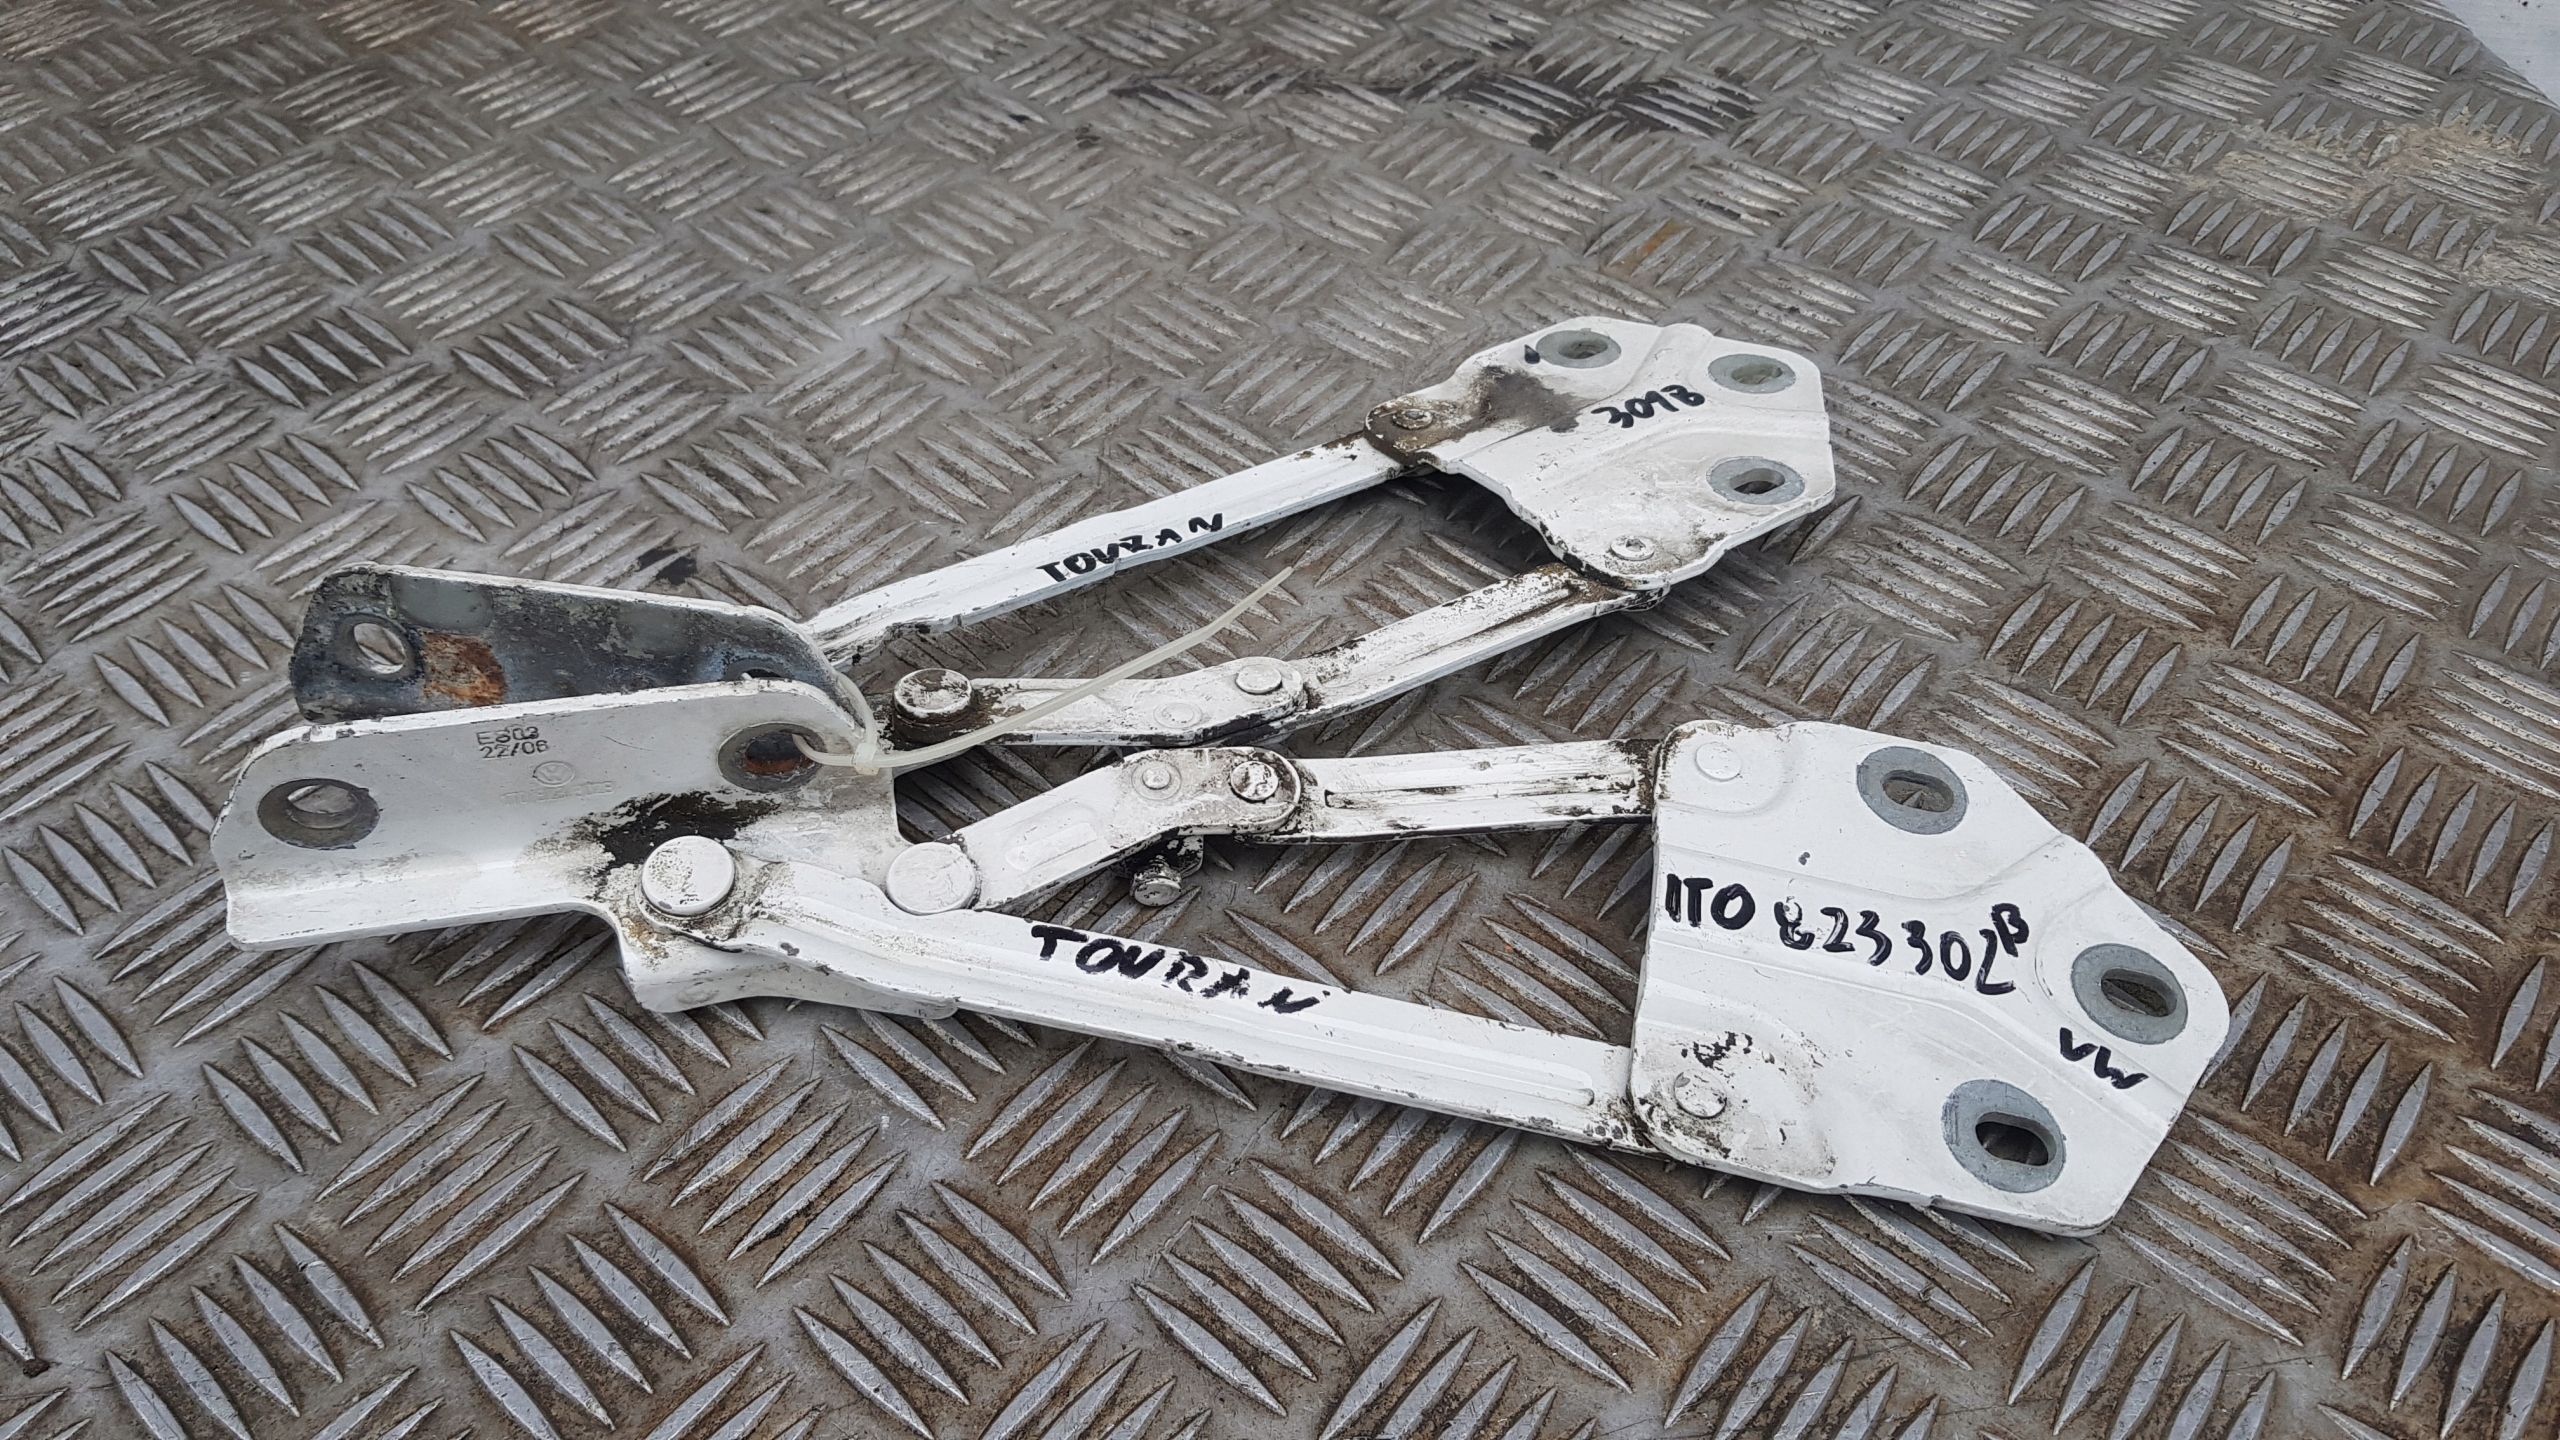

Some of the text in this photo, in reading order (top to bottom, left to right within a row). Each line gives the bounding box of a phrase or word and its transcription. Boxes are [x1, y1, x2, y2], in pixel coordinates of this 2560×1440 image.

[1036, 513, 1223, 582] TOURAN
[1031, 924, 1325, 1014] TOURAN
[2060, 1027, 2149, 1090] VW
